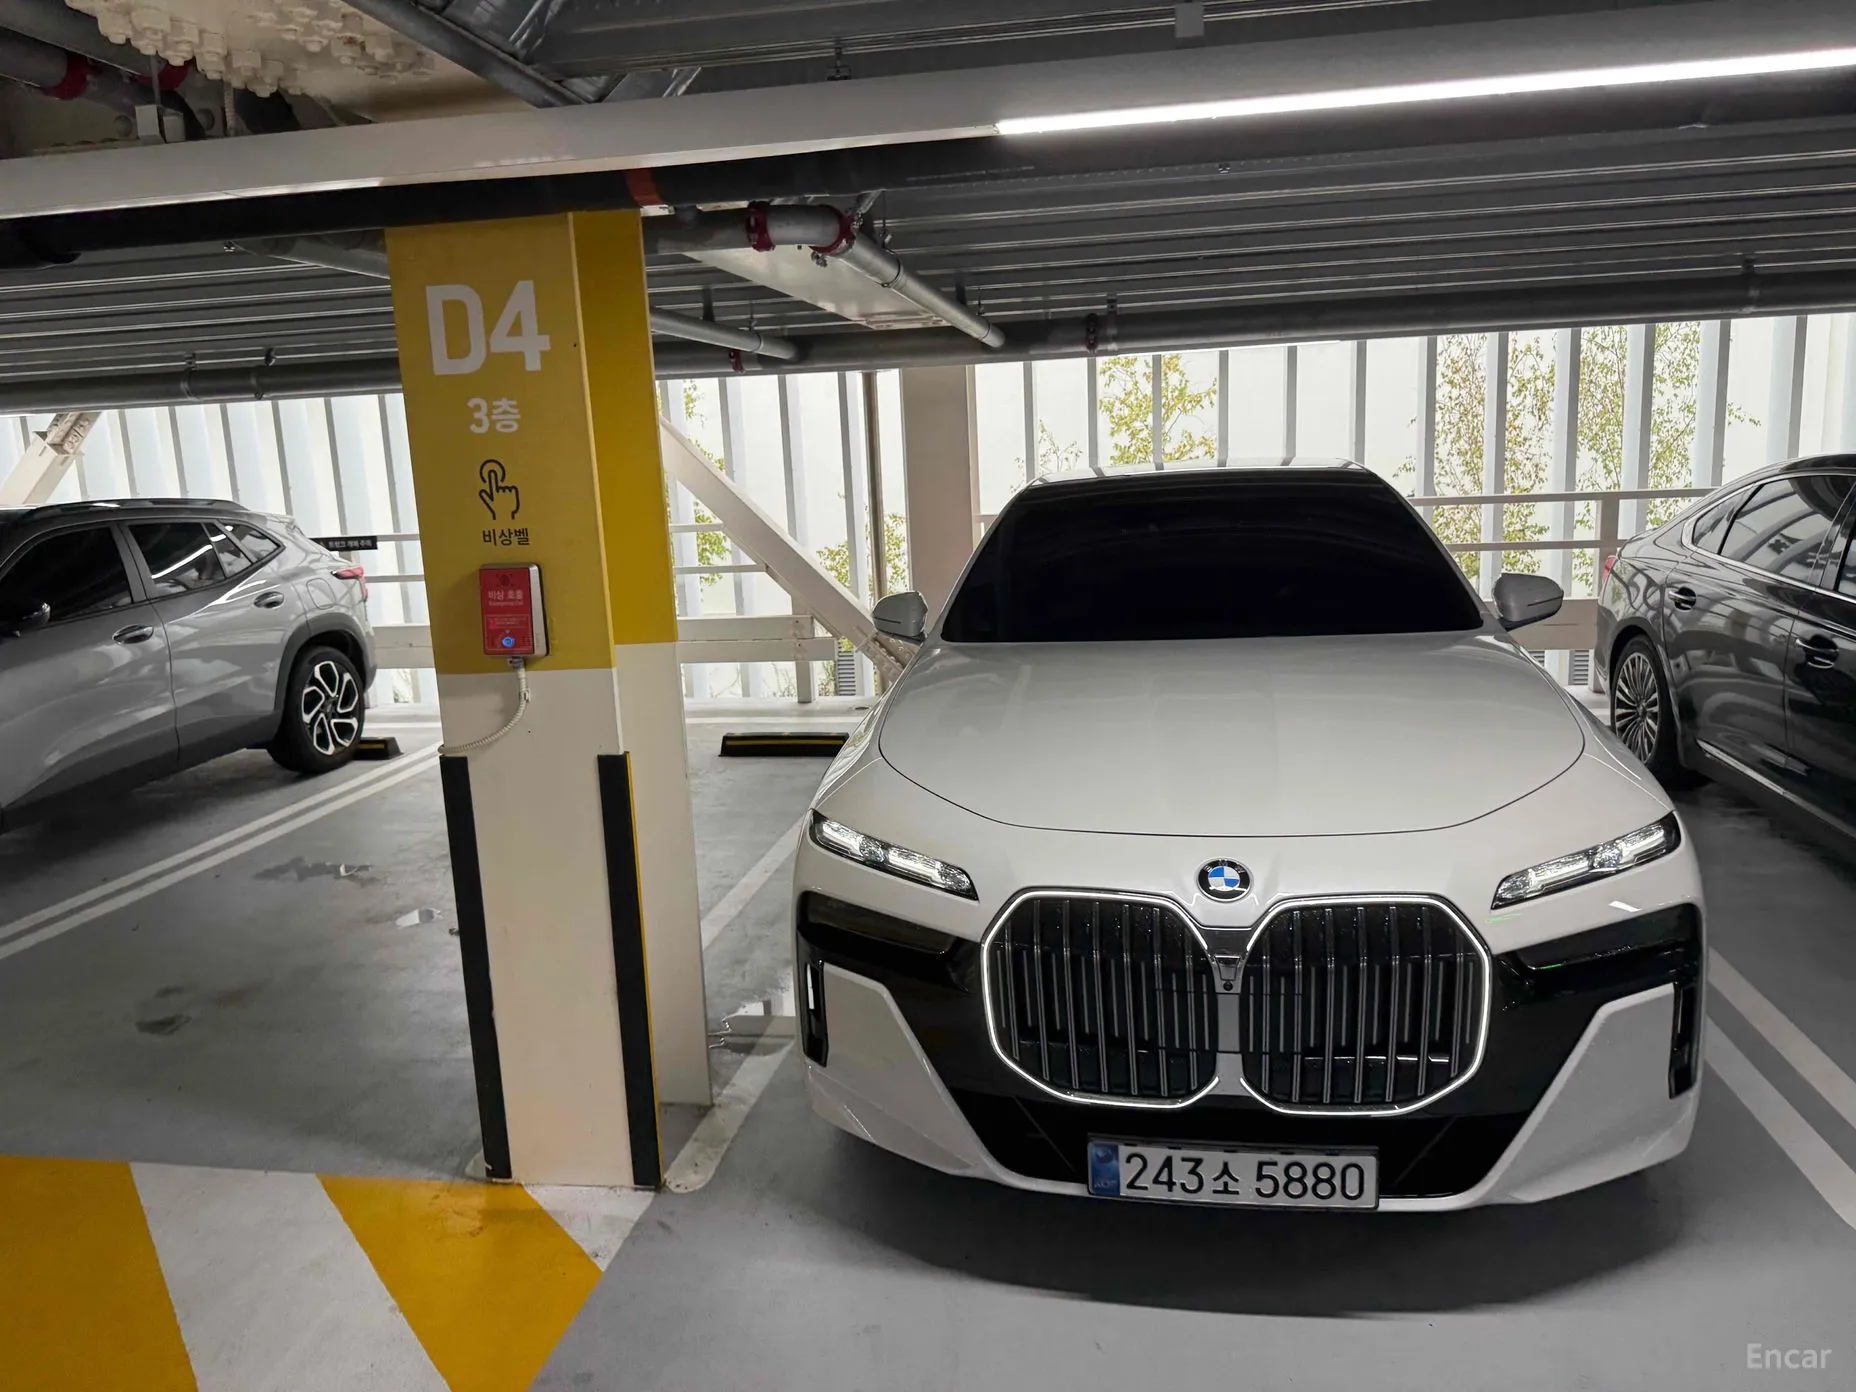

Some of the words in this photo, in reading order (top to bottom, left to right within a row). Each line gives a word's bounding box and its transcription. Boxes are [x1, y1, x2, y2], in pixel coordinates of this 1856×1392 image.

[426, 280, 551, 375] D4
[467, 397, 520, 433] 3층
[482, 528, 530, 546] 비상벨
[488, 589, 504, 600] 비상
[1125, 1152, 1240, 1196] 243소
[1254, 1160, 1365, 1201] 5880
